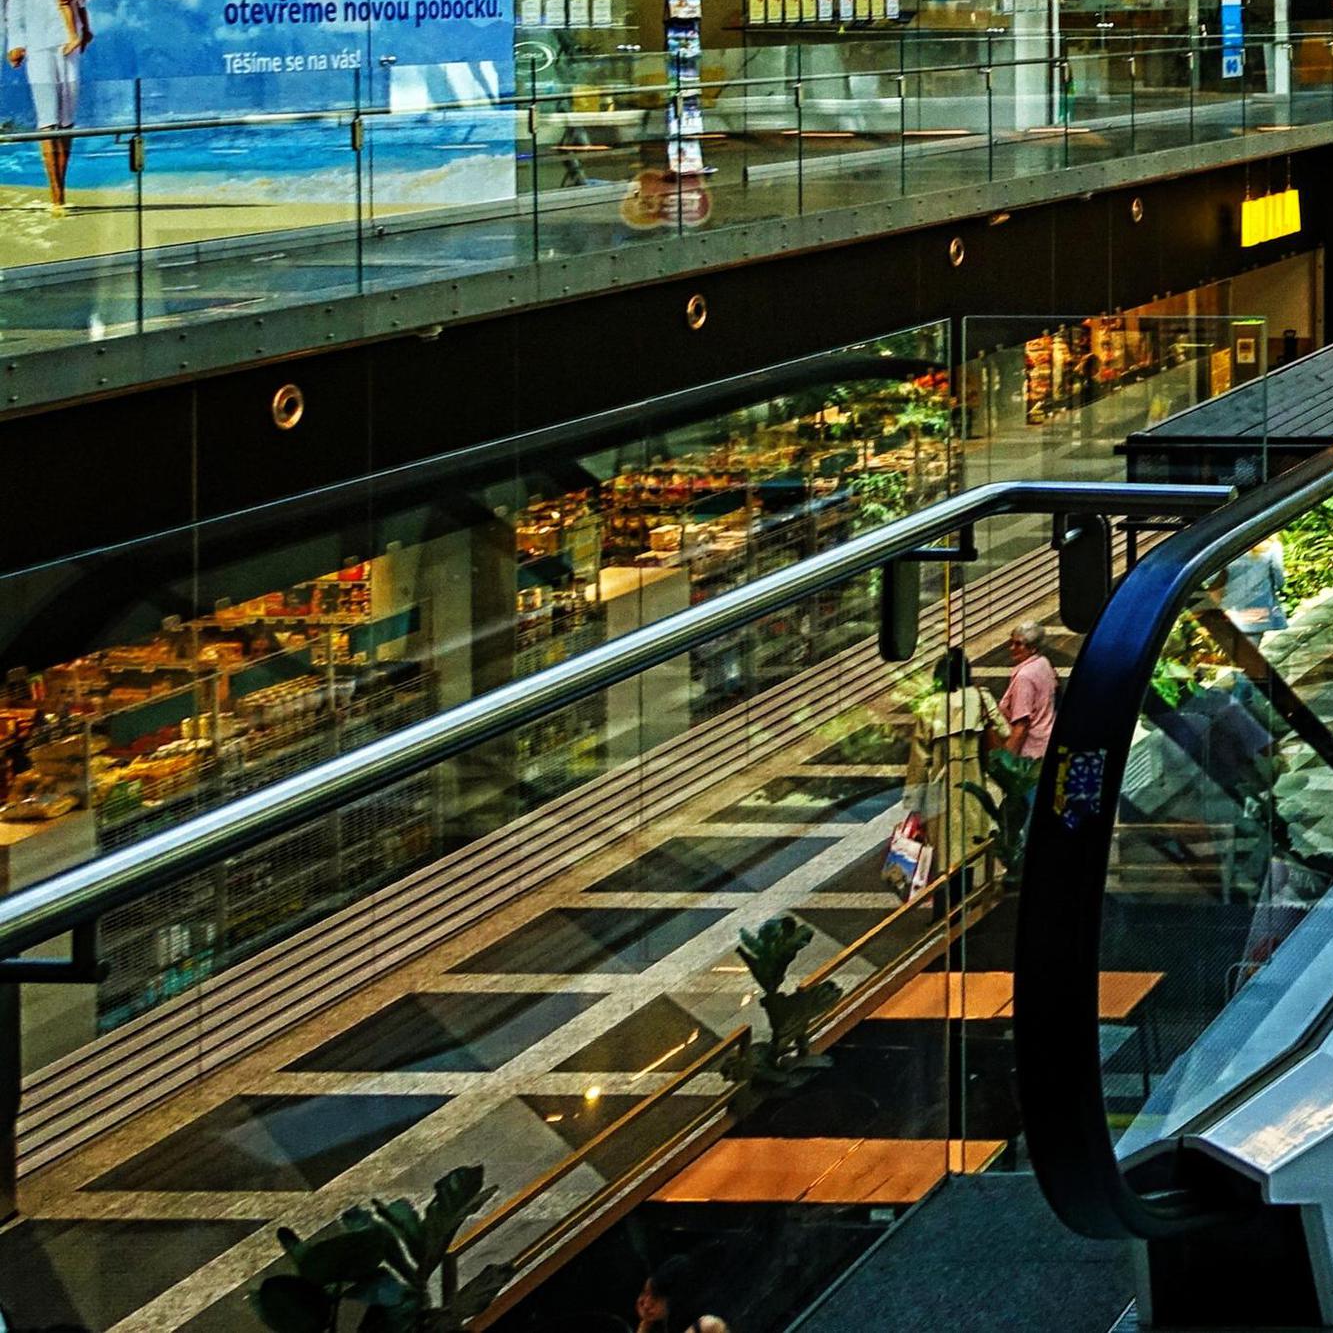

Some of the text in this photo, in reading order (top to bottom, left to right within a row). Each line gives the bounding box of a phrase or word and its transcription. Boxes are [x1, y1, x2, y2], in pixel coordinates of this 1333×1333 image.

[223, 48, 362, 75] Těšíme se na vás!
